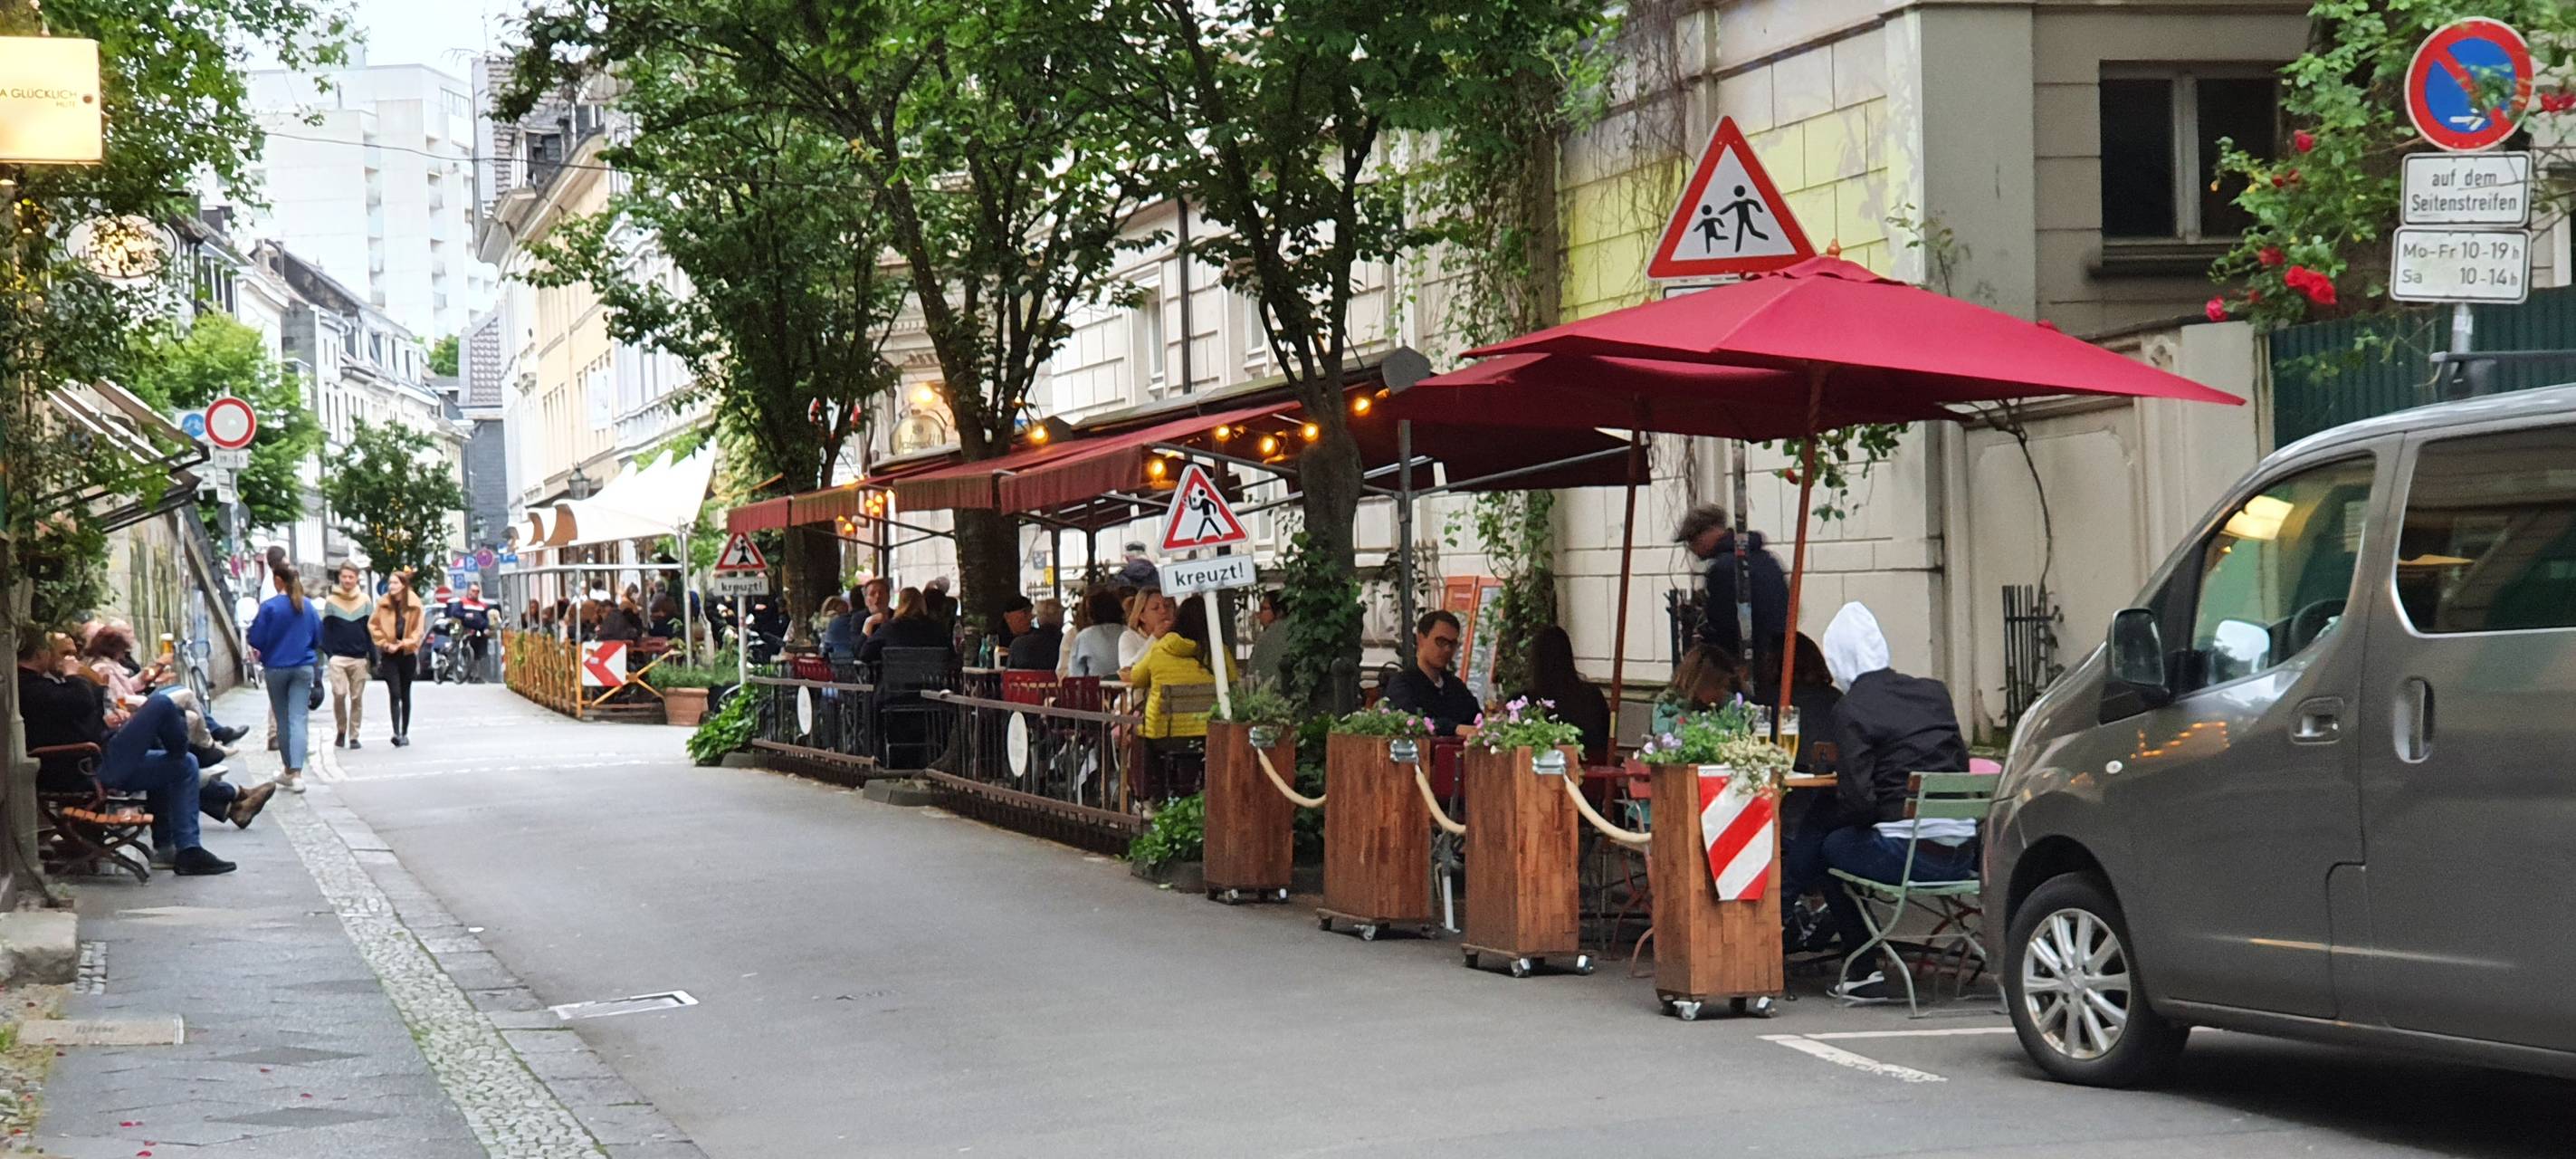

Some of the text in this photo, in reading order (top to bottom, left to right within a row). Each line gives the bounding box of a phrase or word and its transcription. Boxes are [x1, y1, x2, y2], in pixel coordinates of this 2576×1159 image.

[2432, 168, 2497, 187] auf dem
[2411, 193, 2517, 211] Seitenstreifen
[2403, 243, 2457, 259] Mo-Fr
[2401, 269, 2422, 284] Sa
[1175, 561, 1244, 587] kreuzt!
[721, 581, 762, 591] kreuzt!
